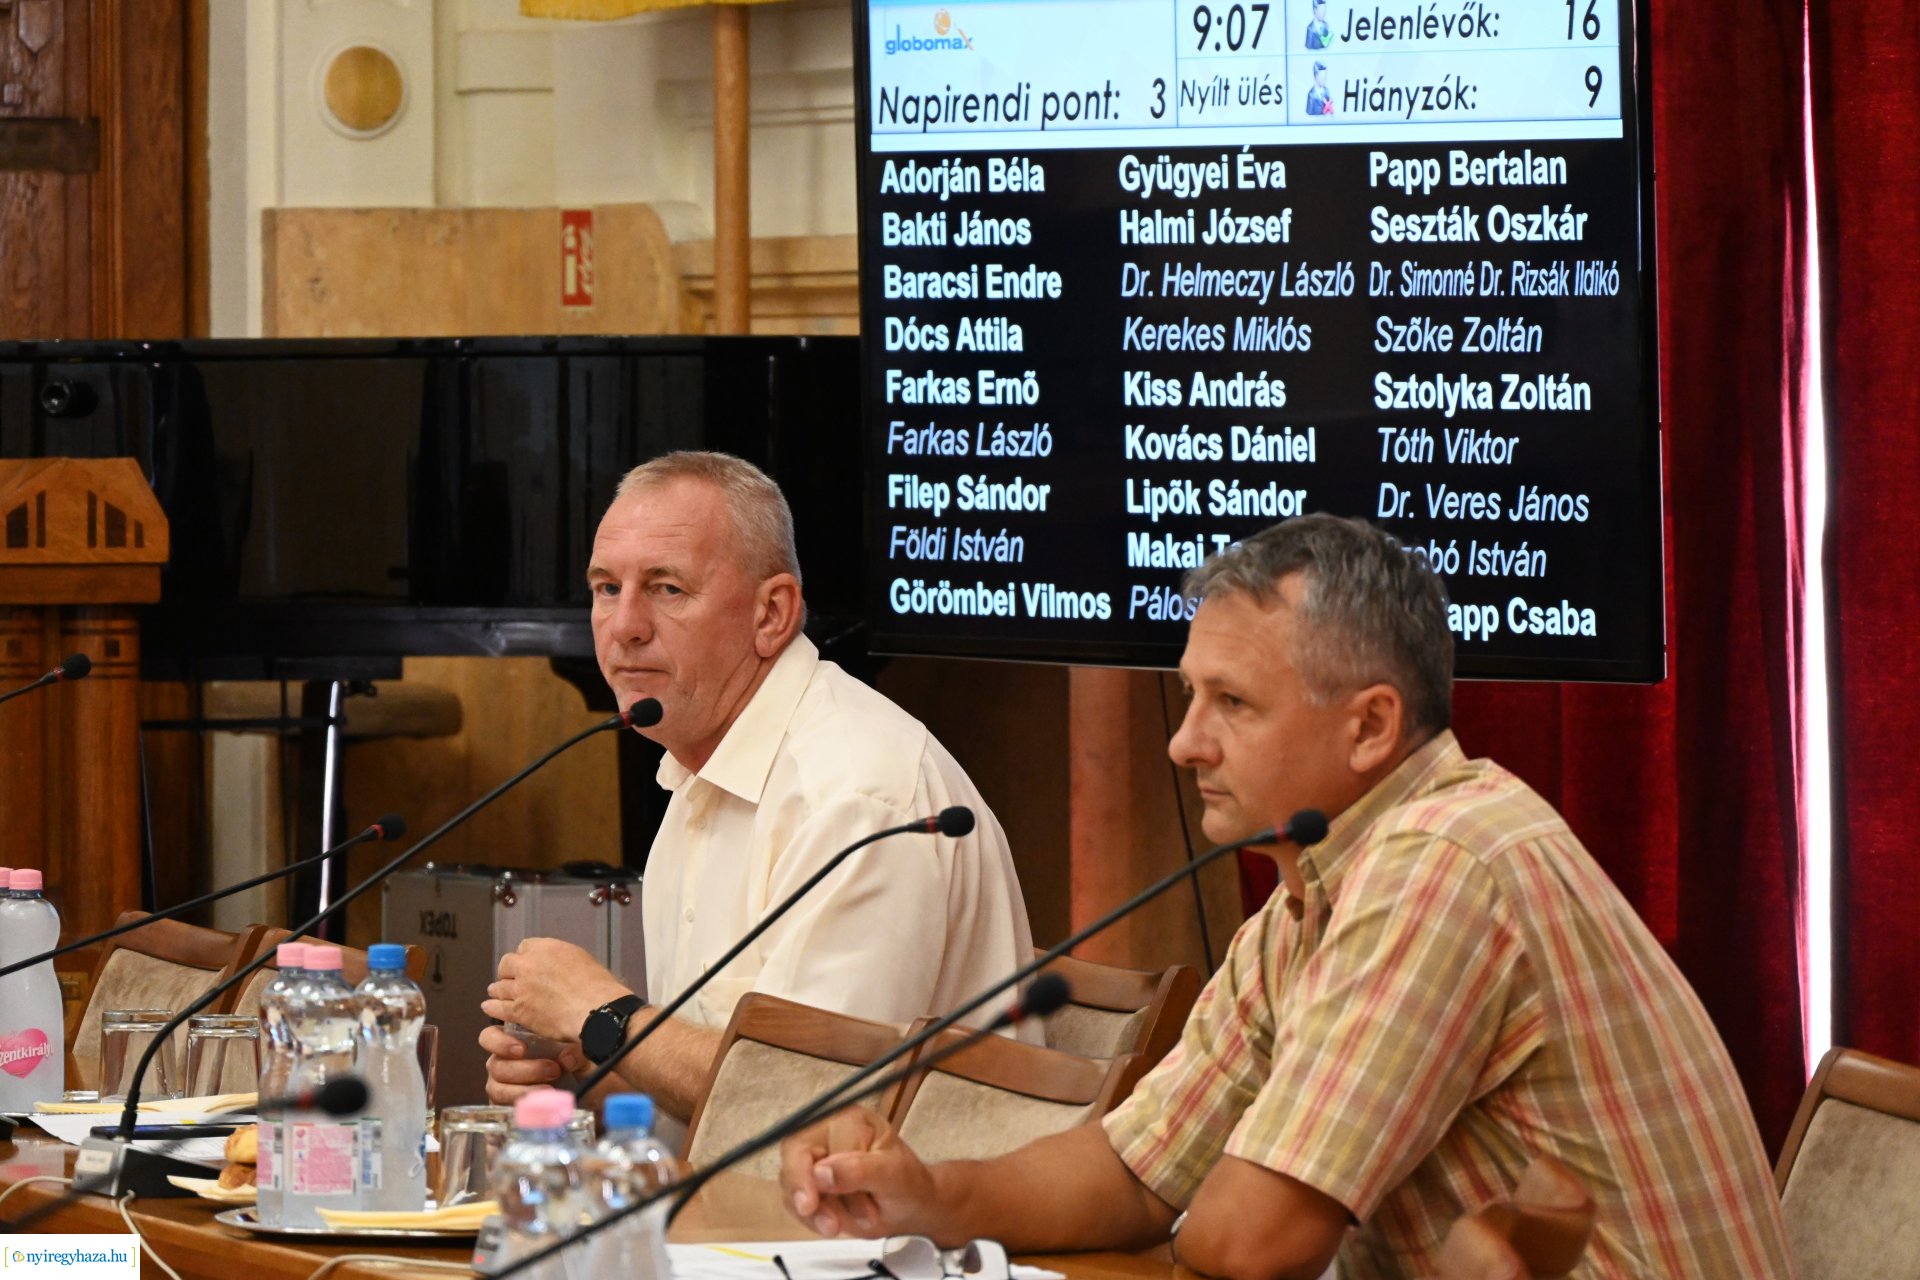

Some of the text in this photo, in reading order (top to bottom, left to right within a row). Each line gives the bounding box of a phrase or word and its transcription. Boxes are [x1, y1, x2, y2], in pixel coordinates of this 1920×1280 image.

[1194, 4, 1269, 51] 9:07
[1341, 2, 1499, 42] Jelenlévők:
[1567, 0, 1601, 41] 16
[885, 24, 974, 55] globomax
[880, 78, 1165, 133] Napirendi pont: 3
[1181, 75, 1282, 113] Nyílt ülés
[1344, 75, 1476, 119] Hiányzók:
[1585, 66, 1602, 108] 9
[880, 157, 1045, 201] Adorján Béla
[1119, 145, 1286, 198] Gyügyei Éva
[1370, 149, 1566, 195] Papp Bertalan
[883, 210, 1031, 246] Bakti János
[1120, 208, 1292, 245] Halmi József
[1371, 204, 1588, 243] Seszták Oszkár
[884, 264, 1062, 298] Baracsi Endre
[1121, 262, 1354, 305] Dr. Helmeczy László
[1369, 260, 1619, 297] Dr. Simonné Dr. Rizsák Ildikó
[885, 316, 1023, 351] Dócs Attila
[1123, 317, 1311, 351] Kerekes Miklós
[1461, 317, 1542, 352] Zoltán
[886, 370, 971, 404] Farkas
[1124, 371, 1286, 407] Kiss András
[1374, 372, 1591, 418] Sztolyka Zoltán
[888, 421, 1052, 457] Farkas László
[1125, 425, 1315, 462] Kovács Dániel
[1378, 427, 1519, 464] Tóth Viktor
[889, 474, 1050, 517] Filep Sándor
[1208, 479, 1306, 516] Sándor
[1378, 483, 1589, 521] Dr. Veres János
[890, 526, 1023, 562] Földi István
[1127, 532, 1204, 568] Makai
[1469, 540, 1546, 577] István
[890, 578, 1111, 619] Görömbei Vilmos
[1129, 584, 1204, 621] Pálos
[1445, 597, 1596, 641] app Csaba
[0, 1040, 53, 1067] zentkirályi
